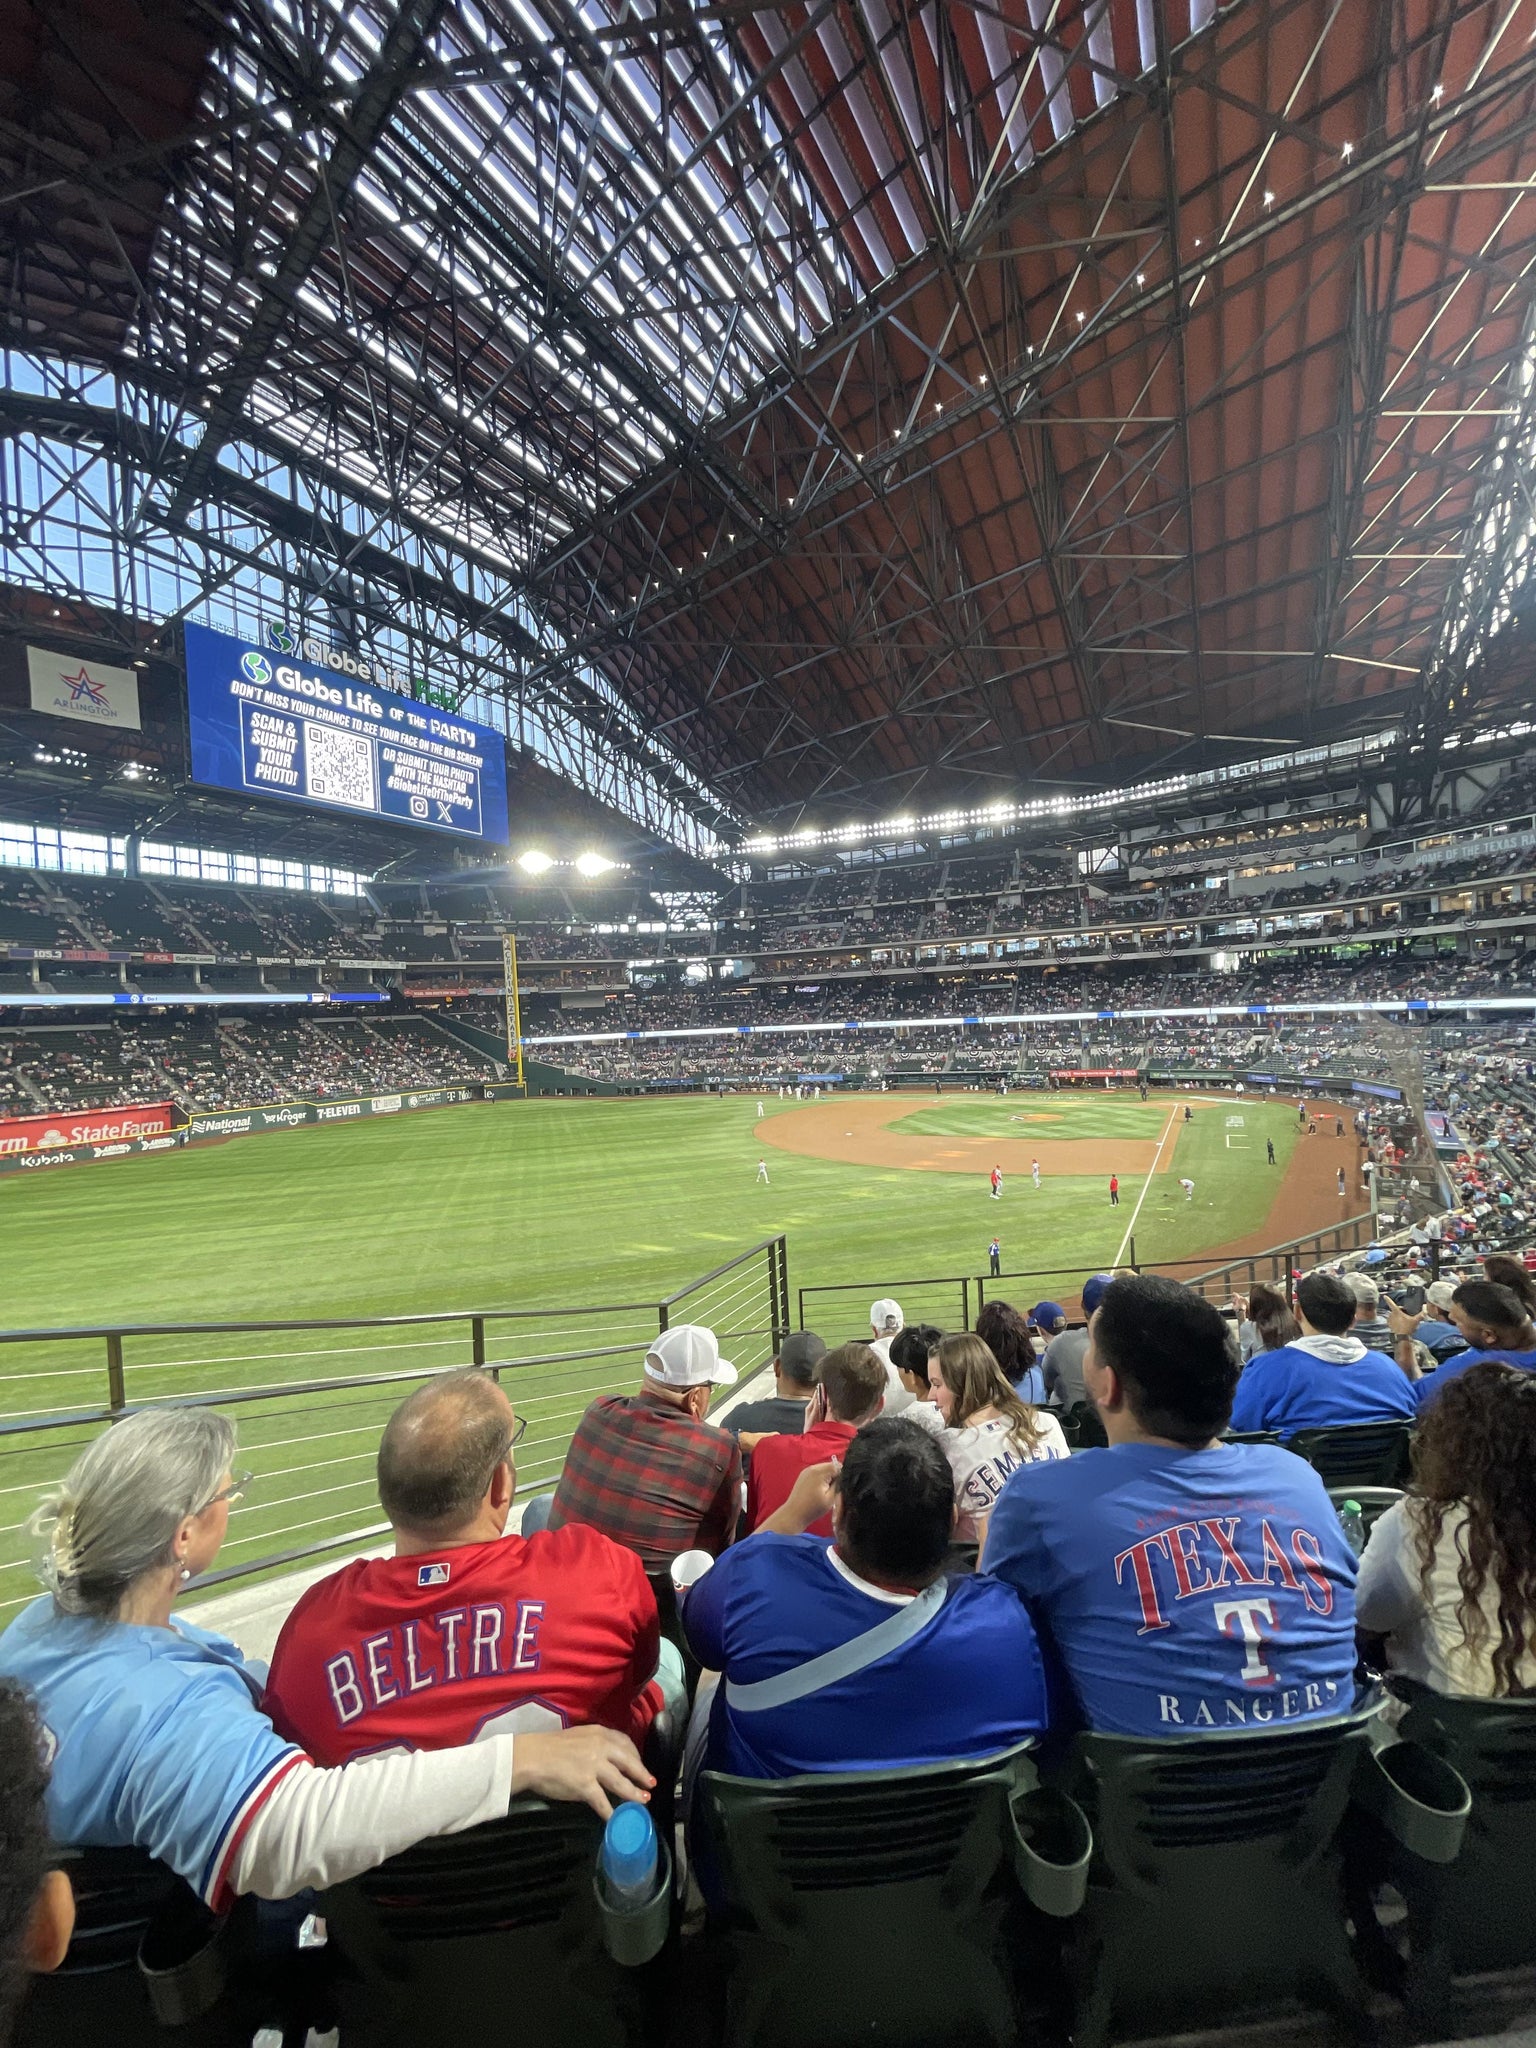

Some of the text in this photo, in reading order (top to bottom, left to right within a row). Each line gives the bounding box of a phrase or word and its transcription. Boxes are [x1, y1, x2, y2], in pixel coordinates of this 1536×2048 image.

[303, 638, 371, 680] Globe
[375, 662, 412, 694] Life
[54, 698, 118, 717] ARLINGTON
[230, 679, 264, 701] DON'T
[264, 690, 290, 710] MISS
[290, 698, 316, 717] YOUR
[316, 707, 350, 727] CHANCE
[351, 717, 363, 730] TO
[363, 720, 379, 736] SEE
[379, 726, 400, 742] YOUR
[400, 733, 418, 748] FACE
[419, 738, 430, 751] ON
[430, 742, 443, 755] THE
[443, 746, 456, 759] BIG
[275, 666, 476, 748] Globe Life OF THE PARTY
[250, 712, 297, 737] SCAN &
[251, 728, 299, 754] SUBMIT
[260, 746, 293, 769] YOUR
[383, 747, 474, 785] OR SUBMIT YOUR PHOTO
[254, 762, 299, 786] PHOTO!
[394, 763, 467, 794] WITH THE HASHTAG
[387, 775, 474, 810] #GlobeLifeOfTheParty
[1416, 851, 1443, 865] HOME
[1445, 848, 1459, 860] OF
[1462, 845, 1480, 857] THE
[1485, 837, 1517, 853] TEXAS
[33, 950, 63, 959] 105.3
[205, 1116, 252, 1132] National
[276, 1108, 307, 1125] Kroger
[317, 1104, 361, 1119] 7-ELEVEN
[20, 1152, 75, 1168] Kubota
[966, 1445, 1061, 1507] SEM
[1114, 1516, 1334, 1636] TEXAS
[323, 1600, 545, 1730] BELTRE
[1157, 1679, 1338, 1725] RANGERS
